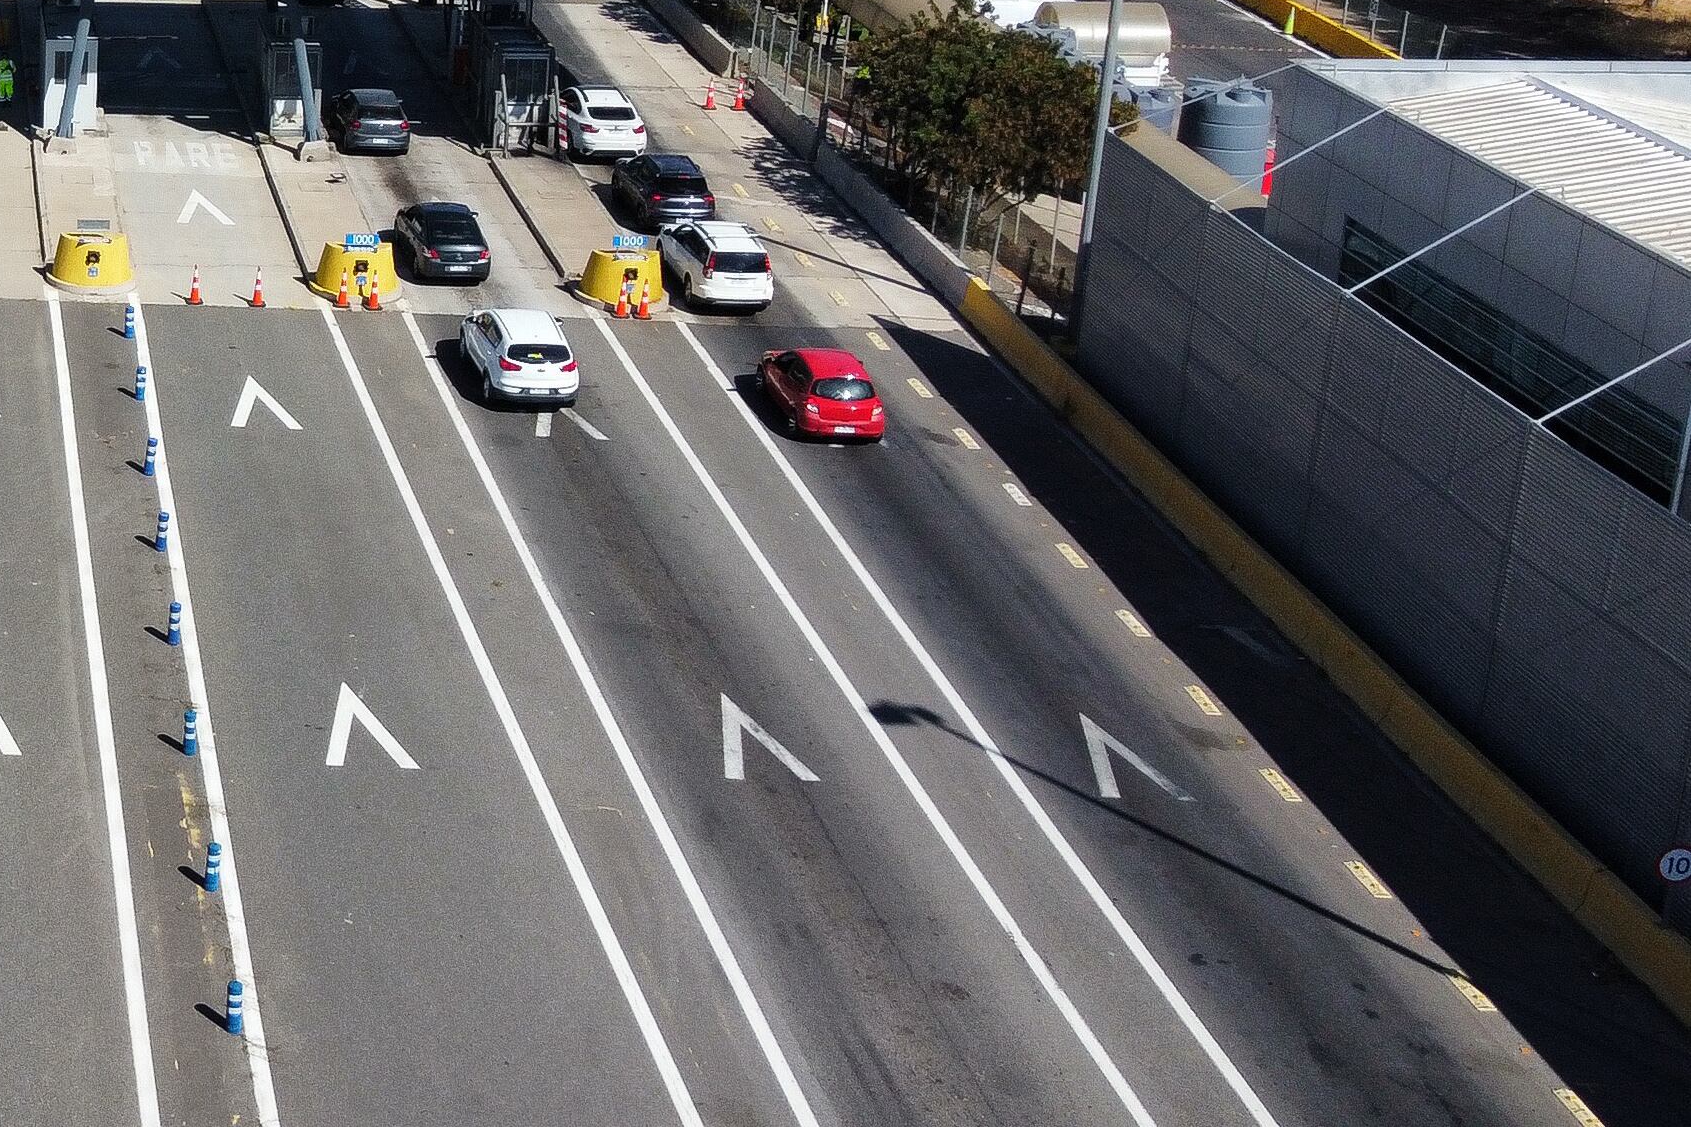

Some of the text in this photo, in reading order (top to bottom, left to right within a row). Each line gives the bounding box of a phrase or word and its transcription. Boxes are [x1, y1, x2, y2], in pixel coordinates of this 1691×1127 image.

[132, 140, 238, 168] PARE
[353, 234, 375, 244] 1000
[620, 235, 644, 246] 1000
[1668, 857, 1690, 874] 10
